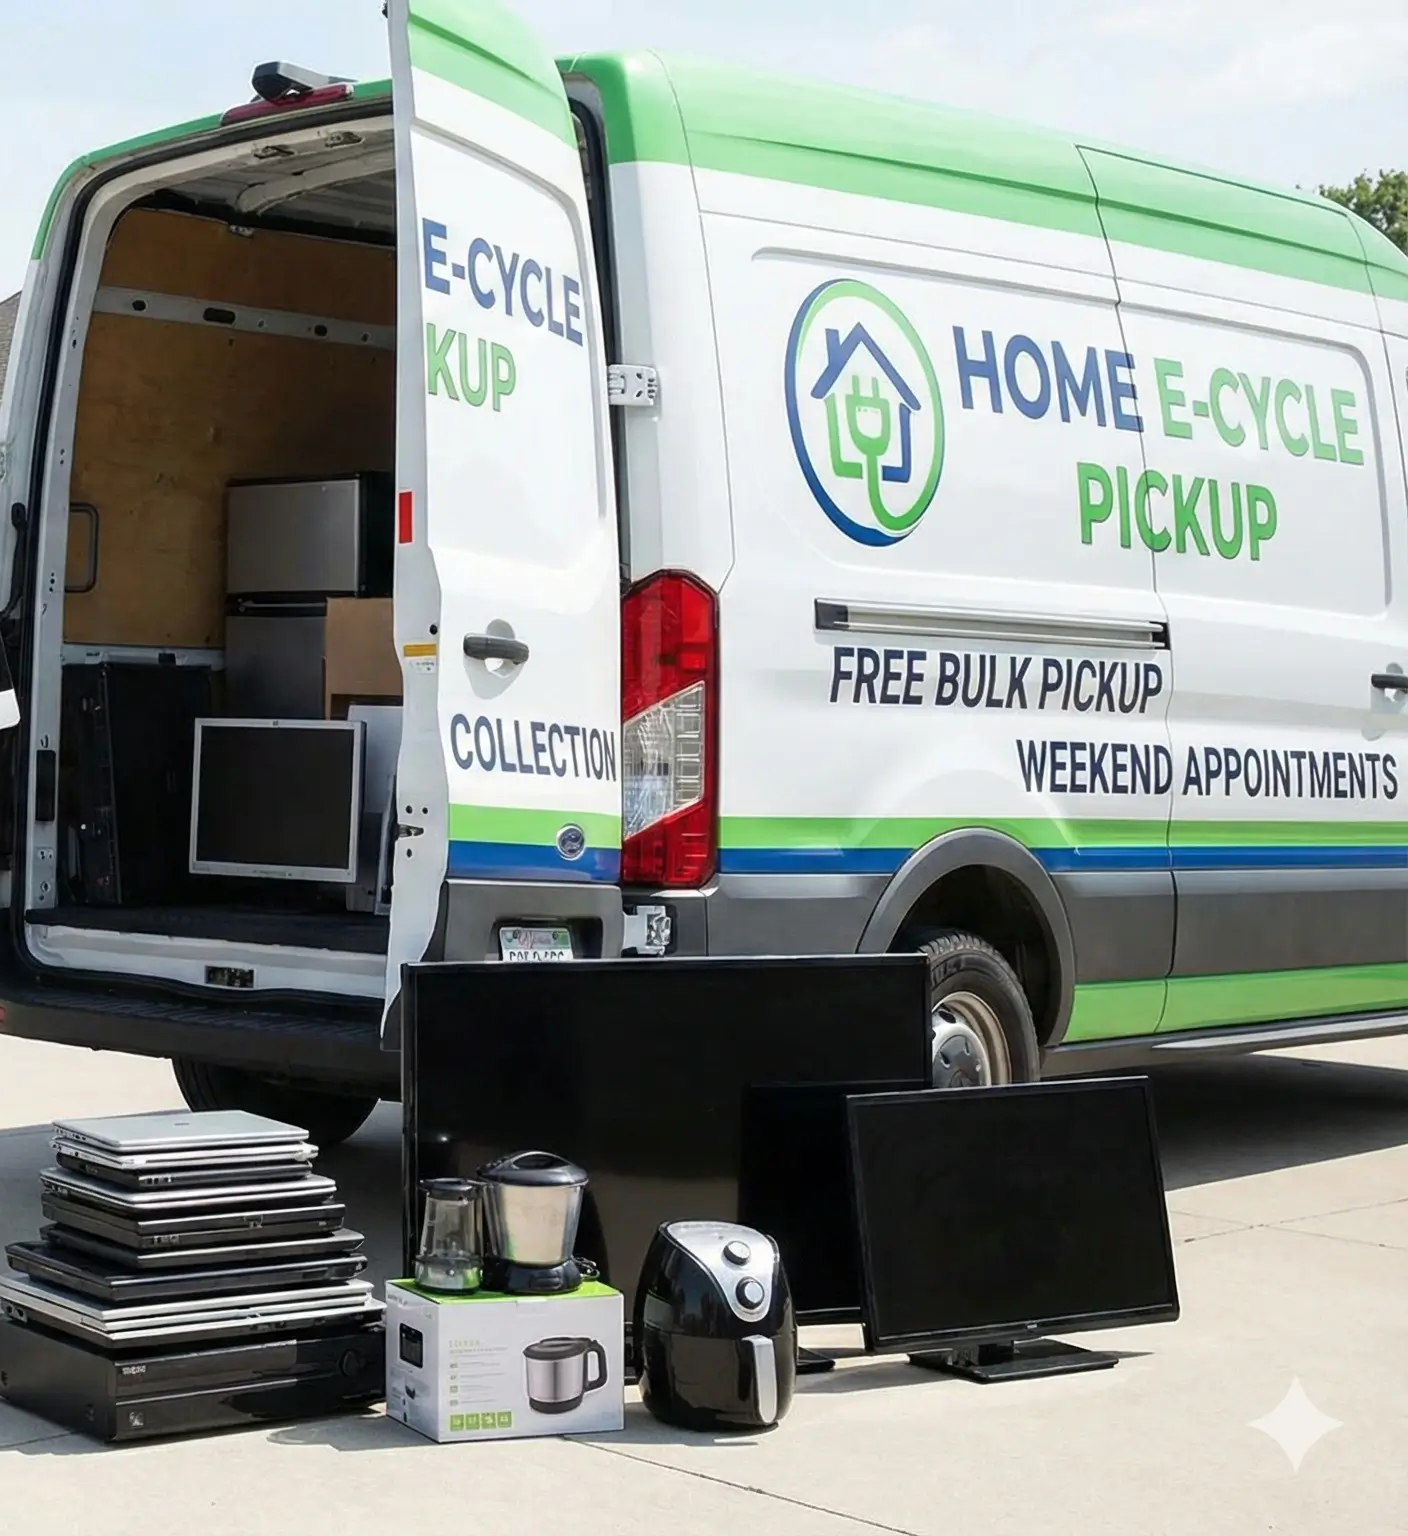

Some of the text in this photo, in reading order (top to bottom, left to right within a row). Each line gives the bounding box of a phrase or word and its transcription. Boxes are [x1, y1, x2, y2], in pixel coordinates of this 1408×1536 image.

[422, 217, 583, 347] E-CYCLE
[425, 322, 516, 412] KUP
[952, 326, 1365, 466] HOME E-CYCLE
[1077, 461, 1277, 561] PICKUP
[829, 646, 1163, 714] FREE BULK PICKUP
[450, 713, 617, 782] COLLECTION
[1016, 739, 1398, 800] WEEKEND APPOINTMENTS
